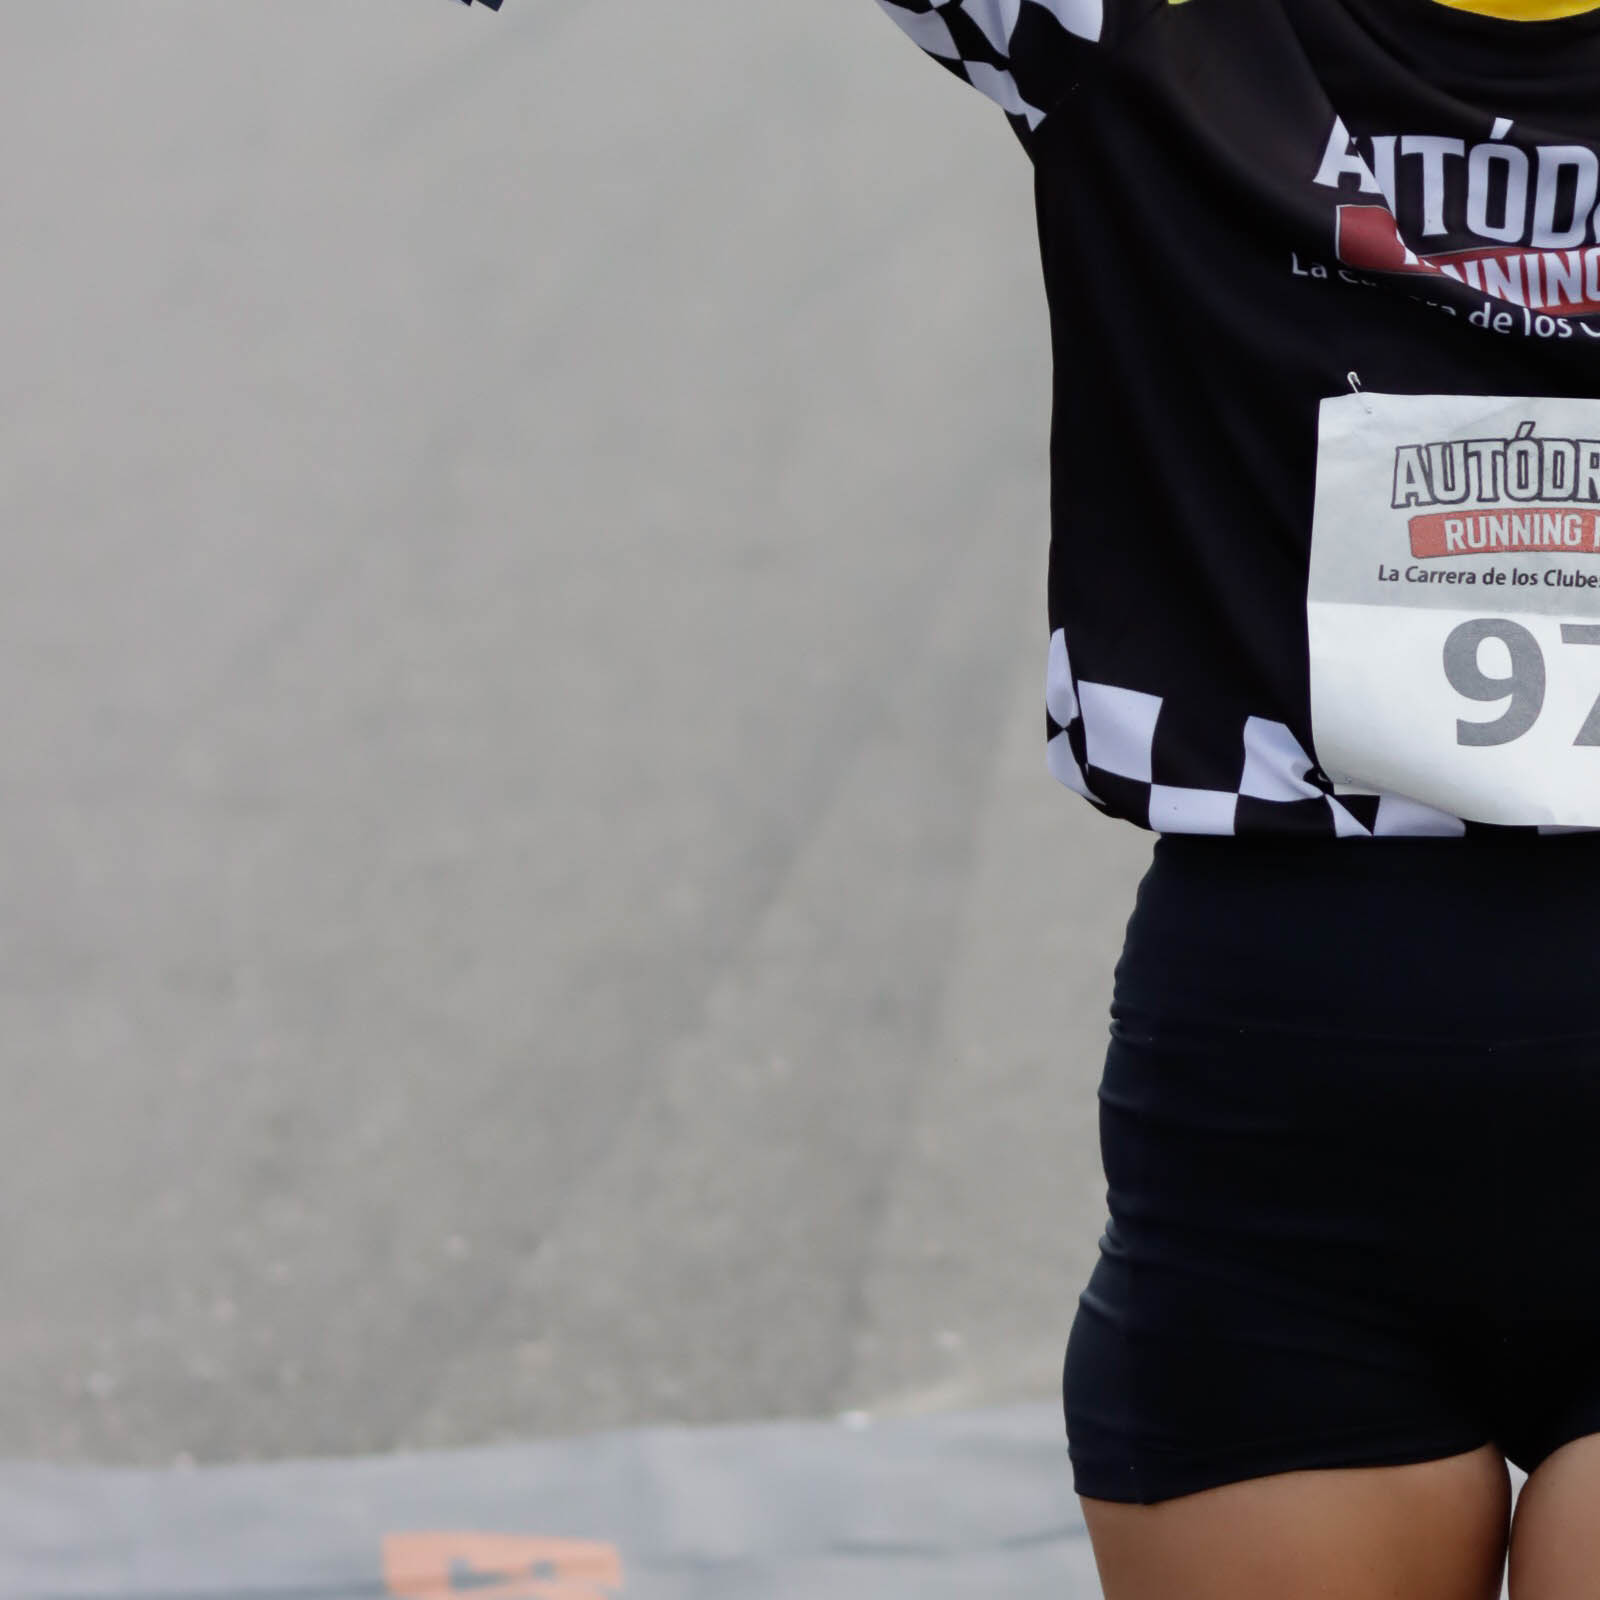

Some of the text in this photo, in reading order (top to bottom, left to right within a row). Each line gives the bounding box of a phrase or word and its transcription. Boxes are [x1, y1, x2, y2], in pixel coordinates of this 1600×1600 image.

[1291, 251, 1328, 279] La
[1468, 301, 1513, 335] de
[1523, 307, 1573, 339] los
[1443, 512, 1583, 552] RUNNING
[1377, 563, 1400, 582] La
[1405, 564, 1476, 585] Carrera
[1482, 567, 1507, 586] de
[1512, 568, 1539, 587] los
